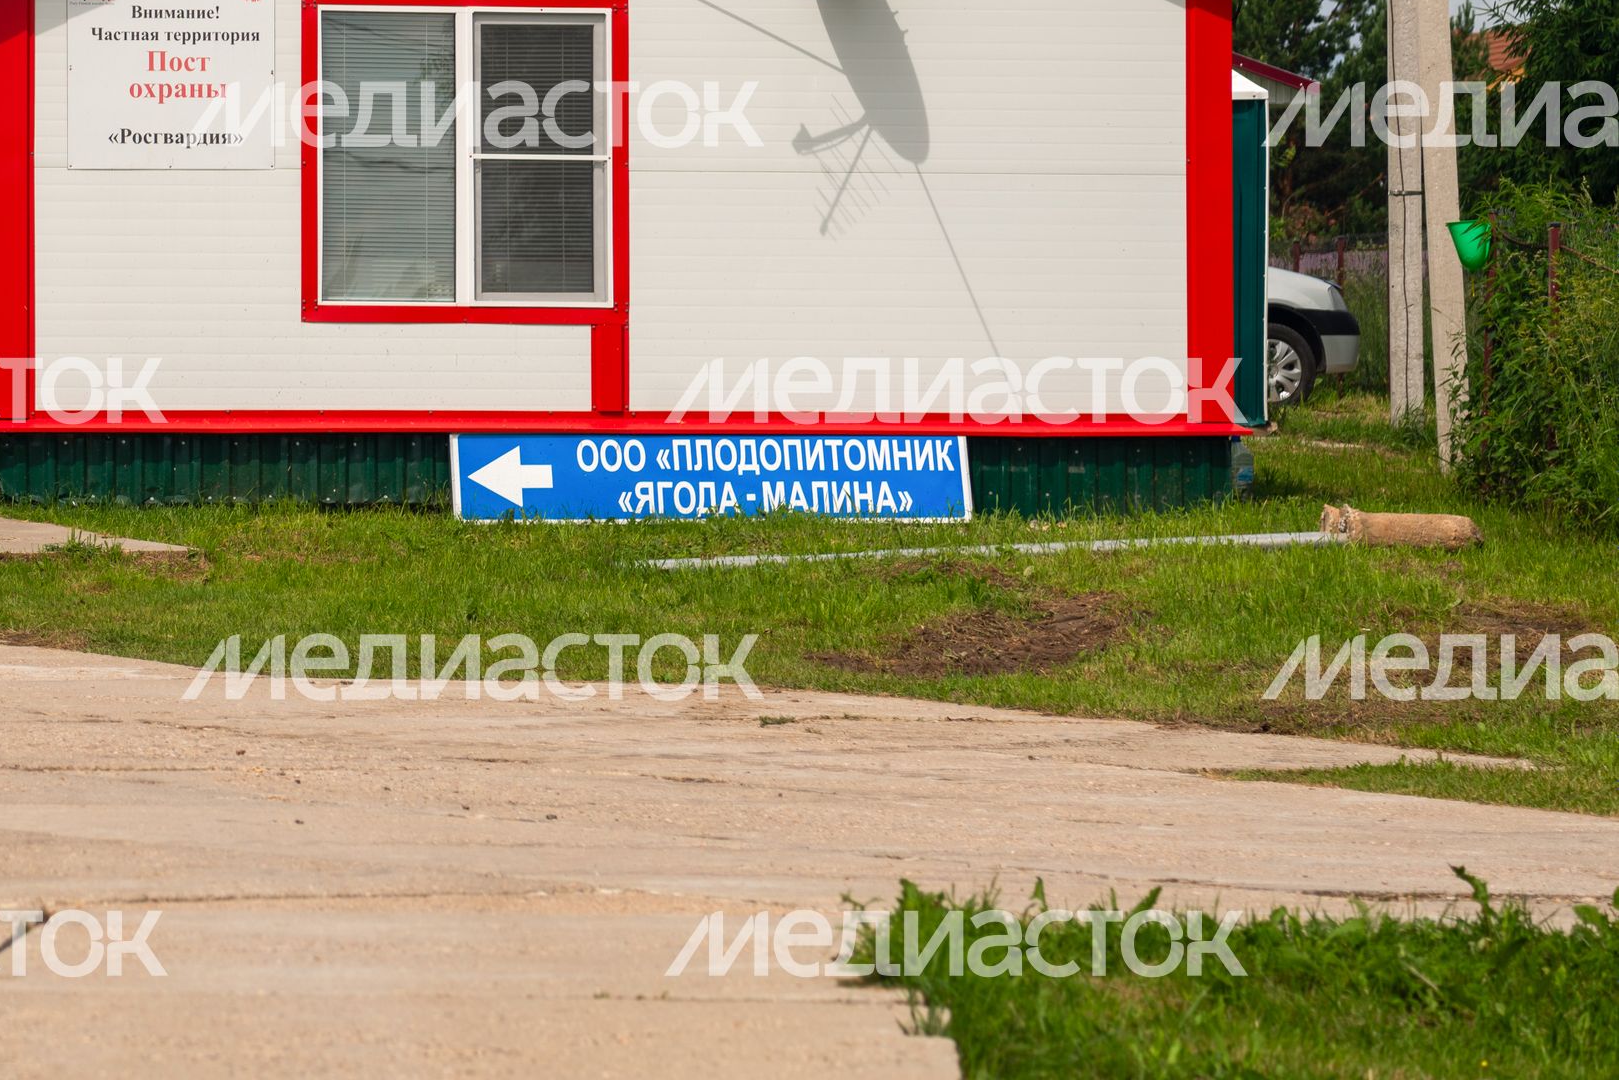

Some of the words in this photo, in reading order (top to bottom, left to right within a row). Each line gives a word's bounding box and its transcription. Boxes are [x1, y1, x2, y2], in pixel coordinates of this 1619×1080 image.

[131, 5, 220, 20] Внимание!
[91, 27, 159, 42] Частная
[164, 29, 260, 45] территория
[146, 50, 210, 72] Пост
[129, 81, 227, 104] охраны
[108, 128, 243, 148] «Росгвардия»
[577, 439, 646, 472] ООО
[656, 439, 955, 476] «ПЛОДОПИТОМНИК
